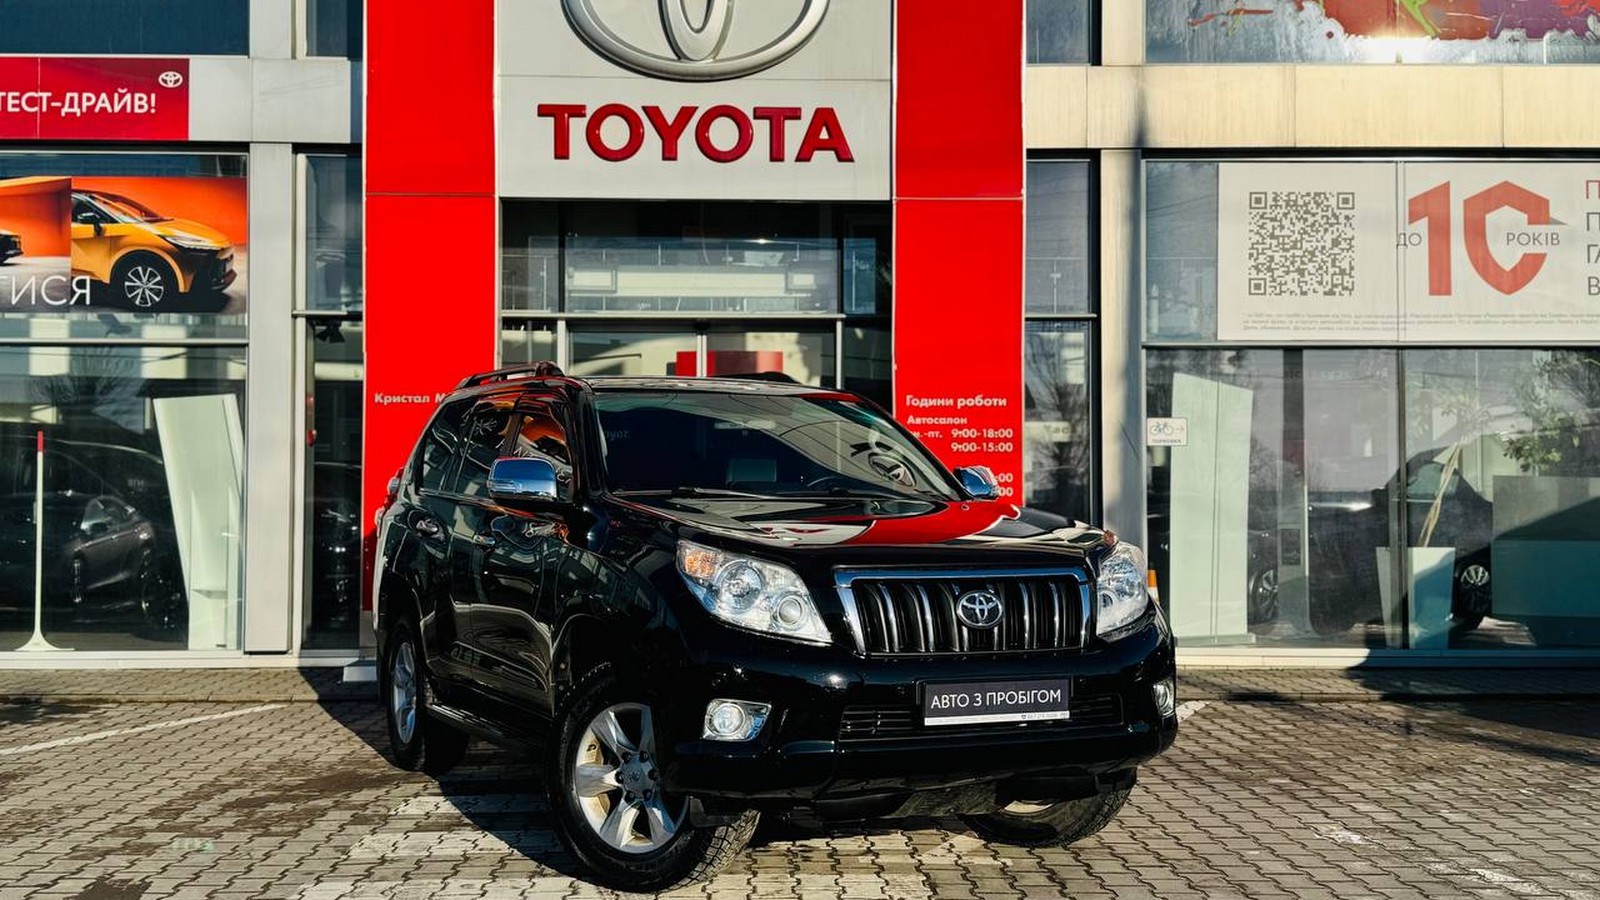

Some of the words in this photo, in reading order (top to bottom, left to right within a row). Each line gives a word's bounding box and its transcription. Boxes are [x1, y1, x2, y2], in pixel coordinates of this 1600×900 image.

[537, 103, 855, 163] TOYOTA
[1396, 232, 1422, 249] ДО
[1506, 231, 1560, 246] РОКІВ
[374, 392, 430, 406] Кристал
[906, 394, 954, 407] Години
[957, 394, 1008, 410] роботи
[907, 415, 968, 425] Автосалон
[951, 428, 1013, 438] 9:00-18:00
[951, 442, 1013, 453] 9:00-15:00
[931, 693, 970, 710] АВТО
[986, 688, 1062, 706] ПРОБІГОМ
